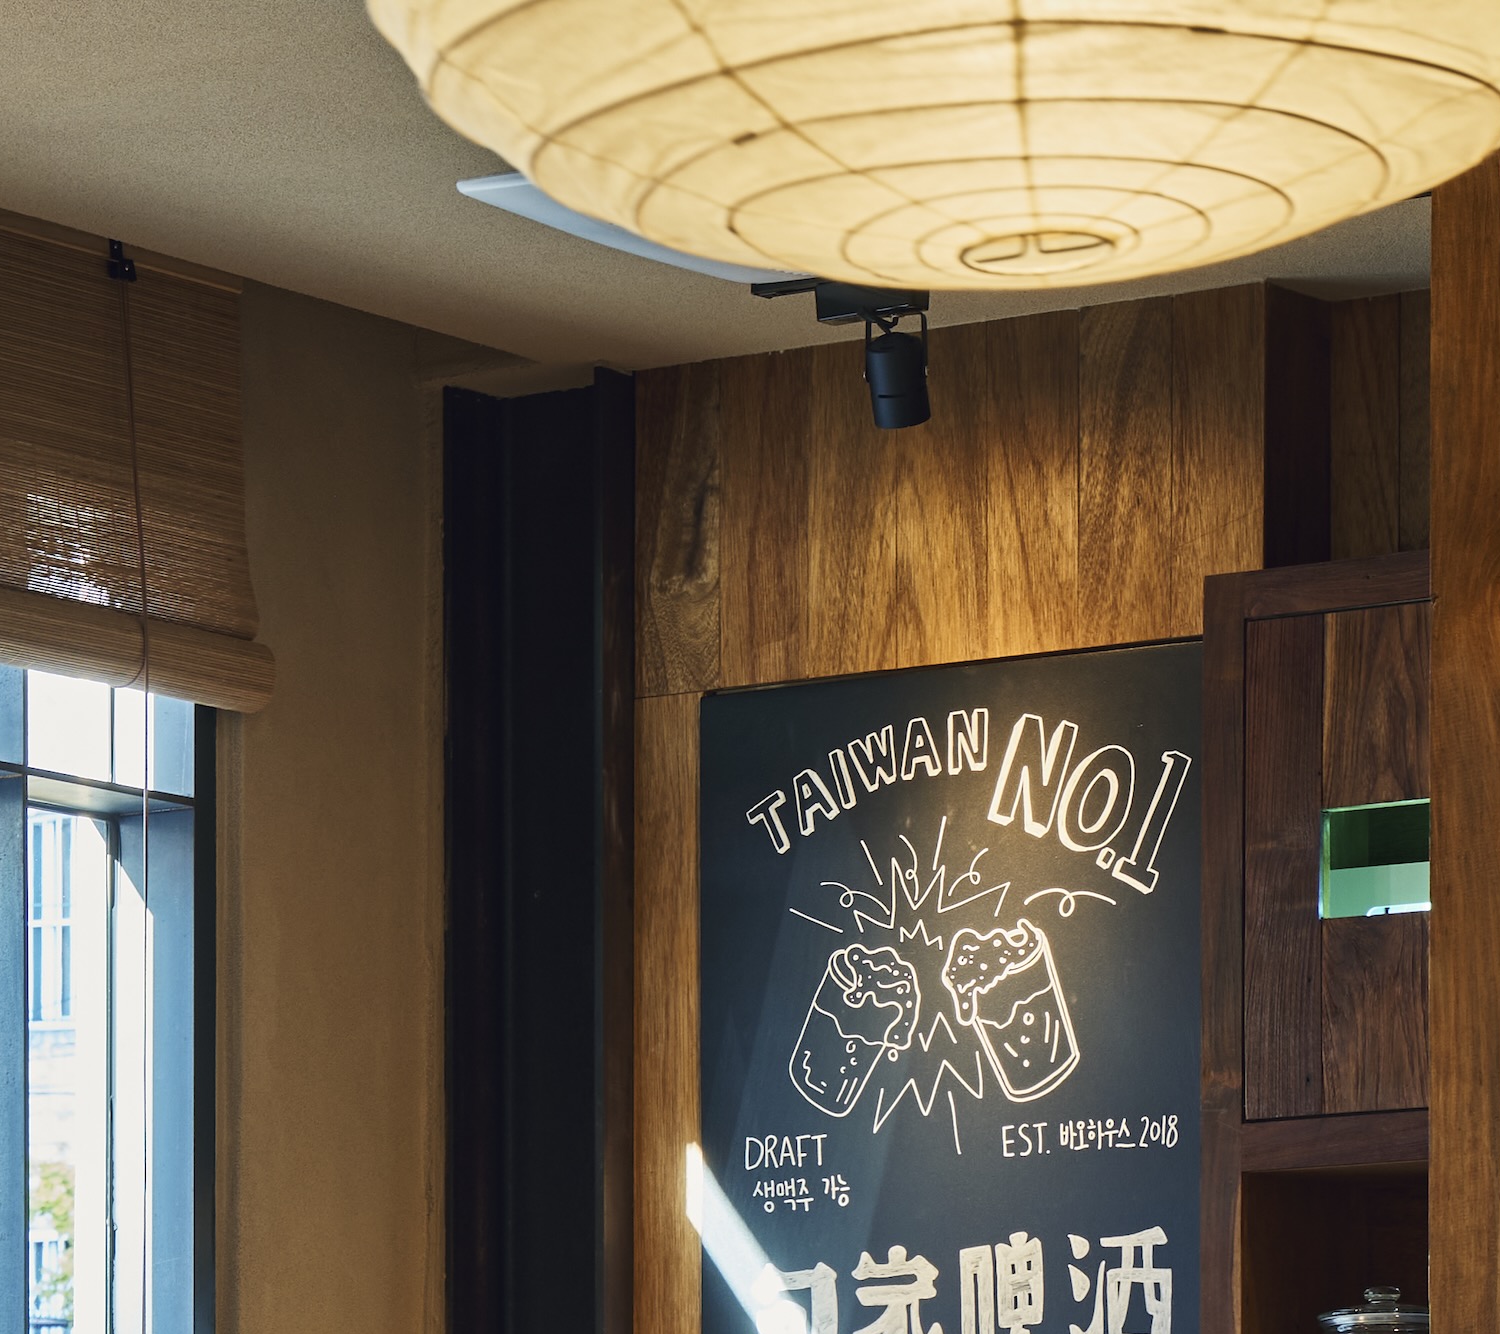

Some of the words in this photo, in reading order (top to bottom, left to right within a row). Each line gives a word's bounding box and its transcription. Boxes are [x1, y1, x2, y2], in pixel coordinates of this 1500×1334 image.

[745, 708, 989, 854] TAIWAN
[745, 1133, 828, 1171] DRAFT
[1001, 1121, 1051, 1158] EST.
[1059, 1117, 1136, 1150] 바오하우스
[1139, 1114, 1179, 1148] 2018
[752, 1177, 815, 1214] 생맥주
[821, 1173, 851, 1208] 가능
